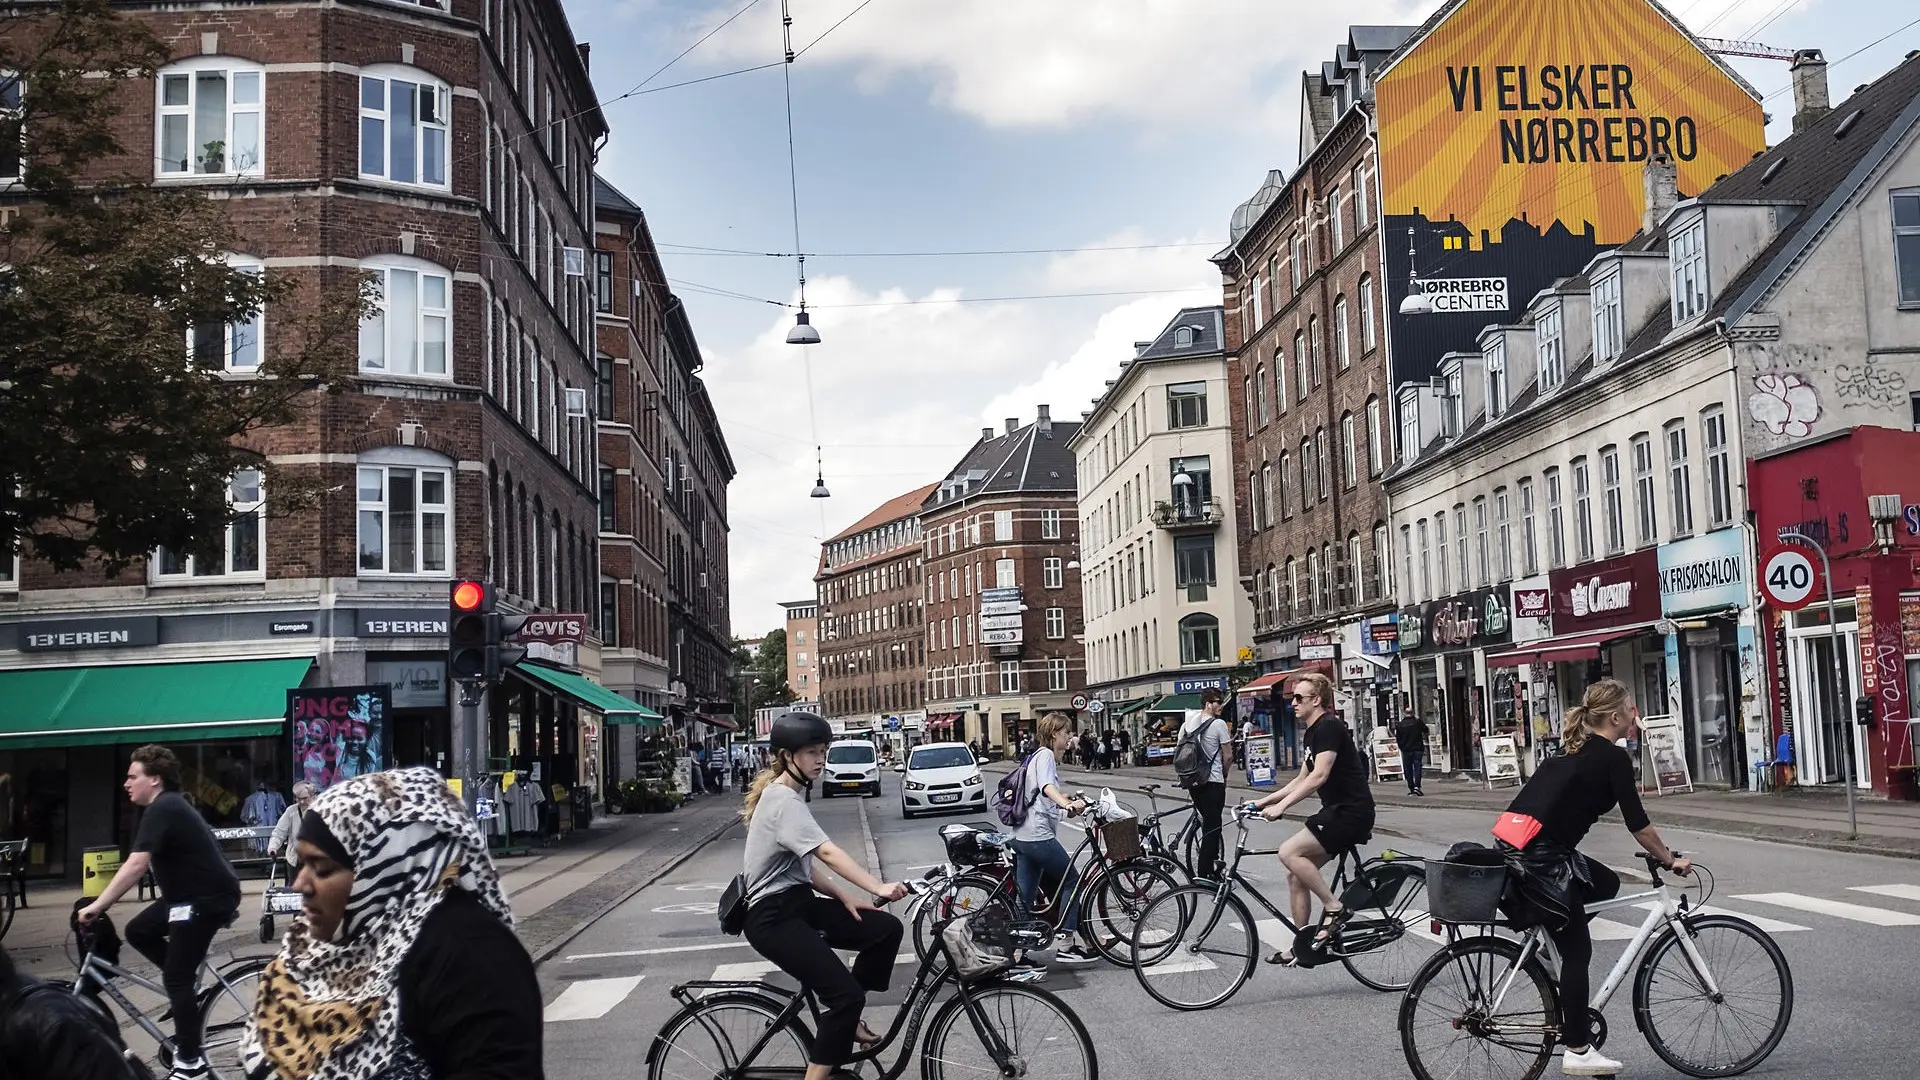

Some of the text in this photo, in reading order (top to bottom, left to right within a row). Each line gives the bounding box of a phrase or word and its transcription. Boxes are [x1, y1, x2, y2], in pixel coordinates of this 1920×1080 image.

[1446, 64, 1637, 112] VI ELSKER
[1500, 115, 1698, 165] NØRREBRO
[1670, 555, 1741, 593] FRISØRSALON
[1768, 563, 1809, 590] 40
[1519, 608, 1549, 617] Caesar
[273, 623, 309, 632] Esromgade
[1180, 681, 1220, 691] 10 PLUS
[1073, 700, 1086, 708] 40
